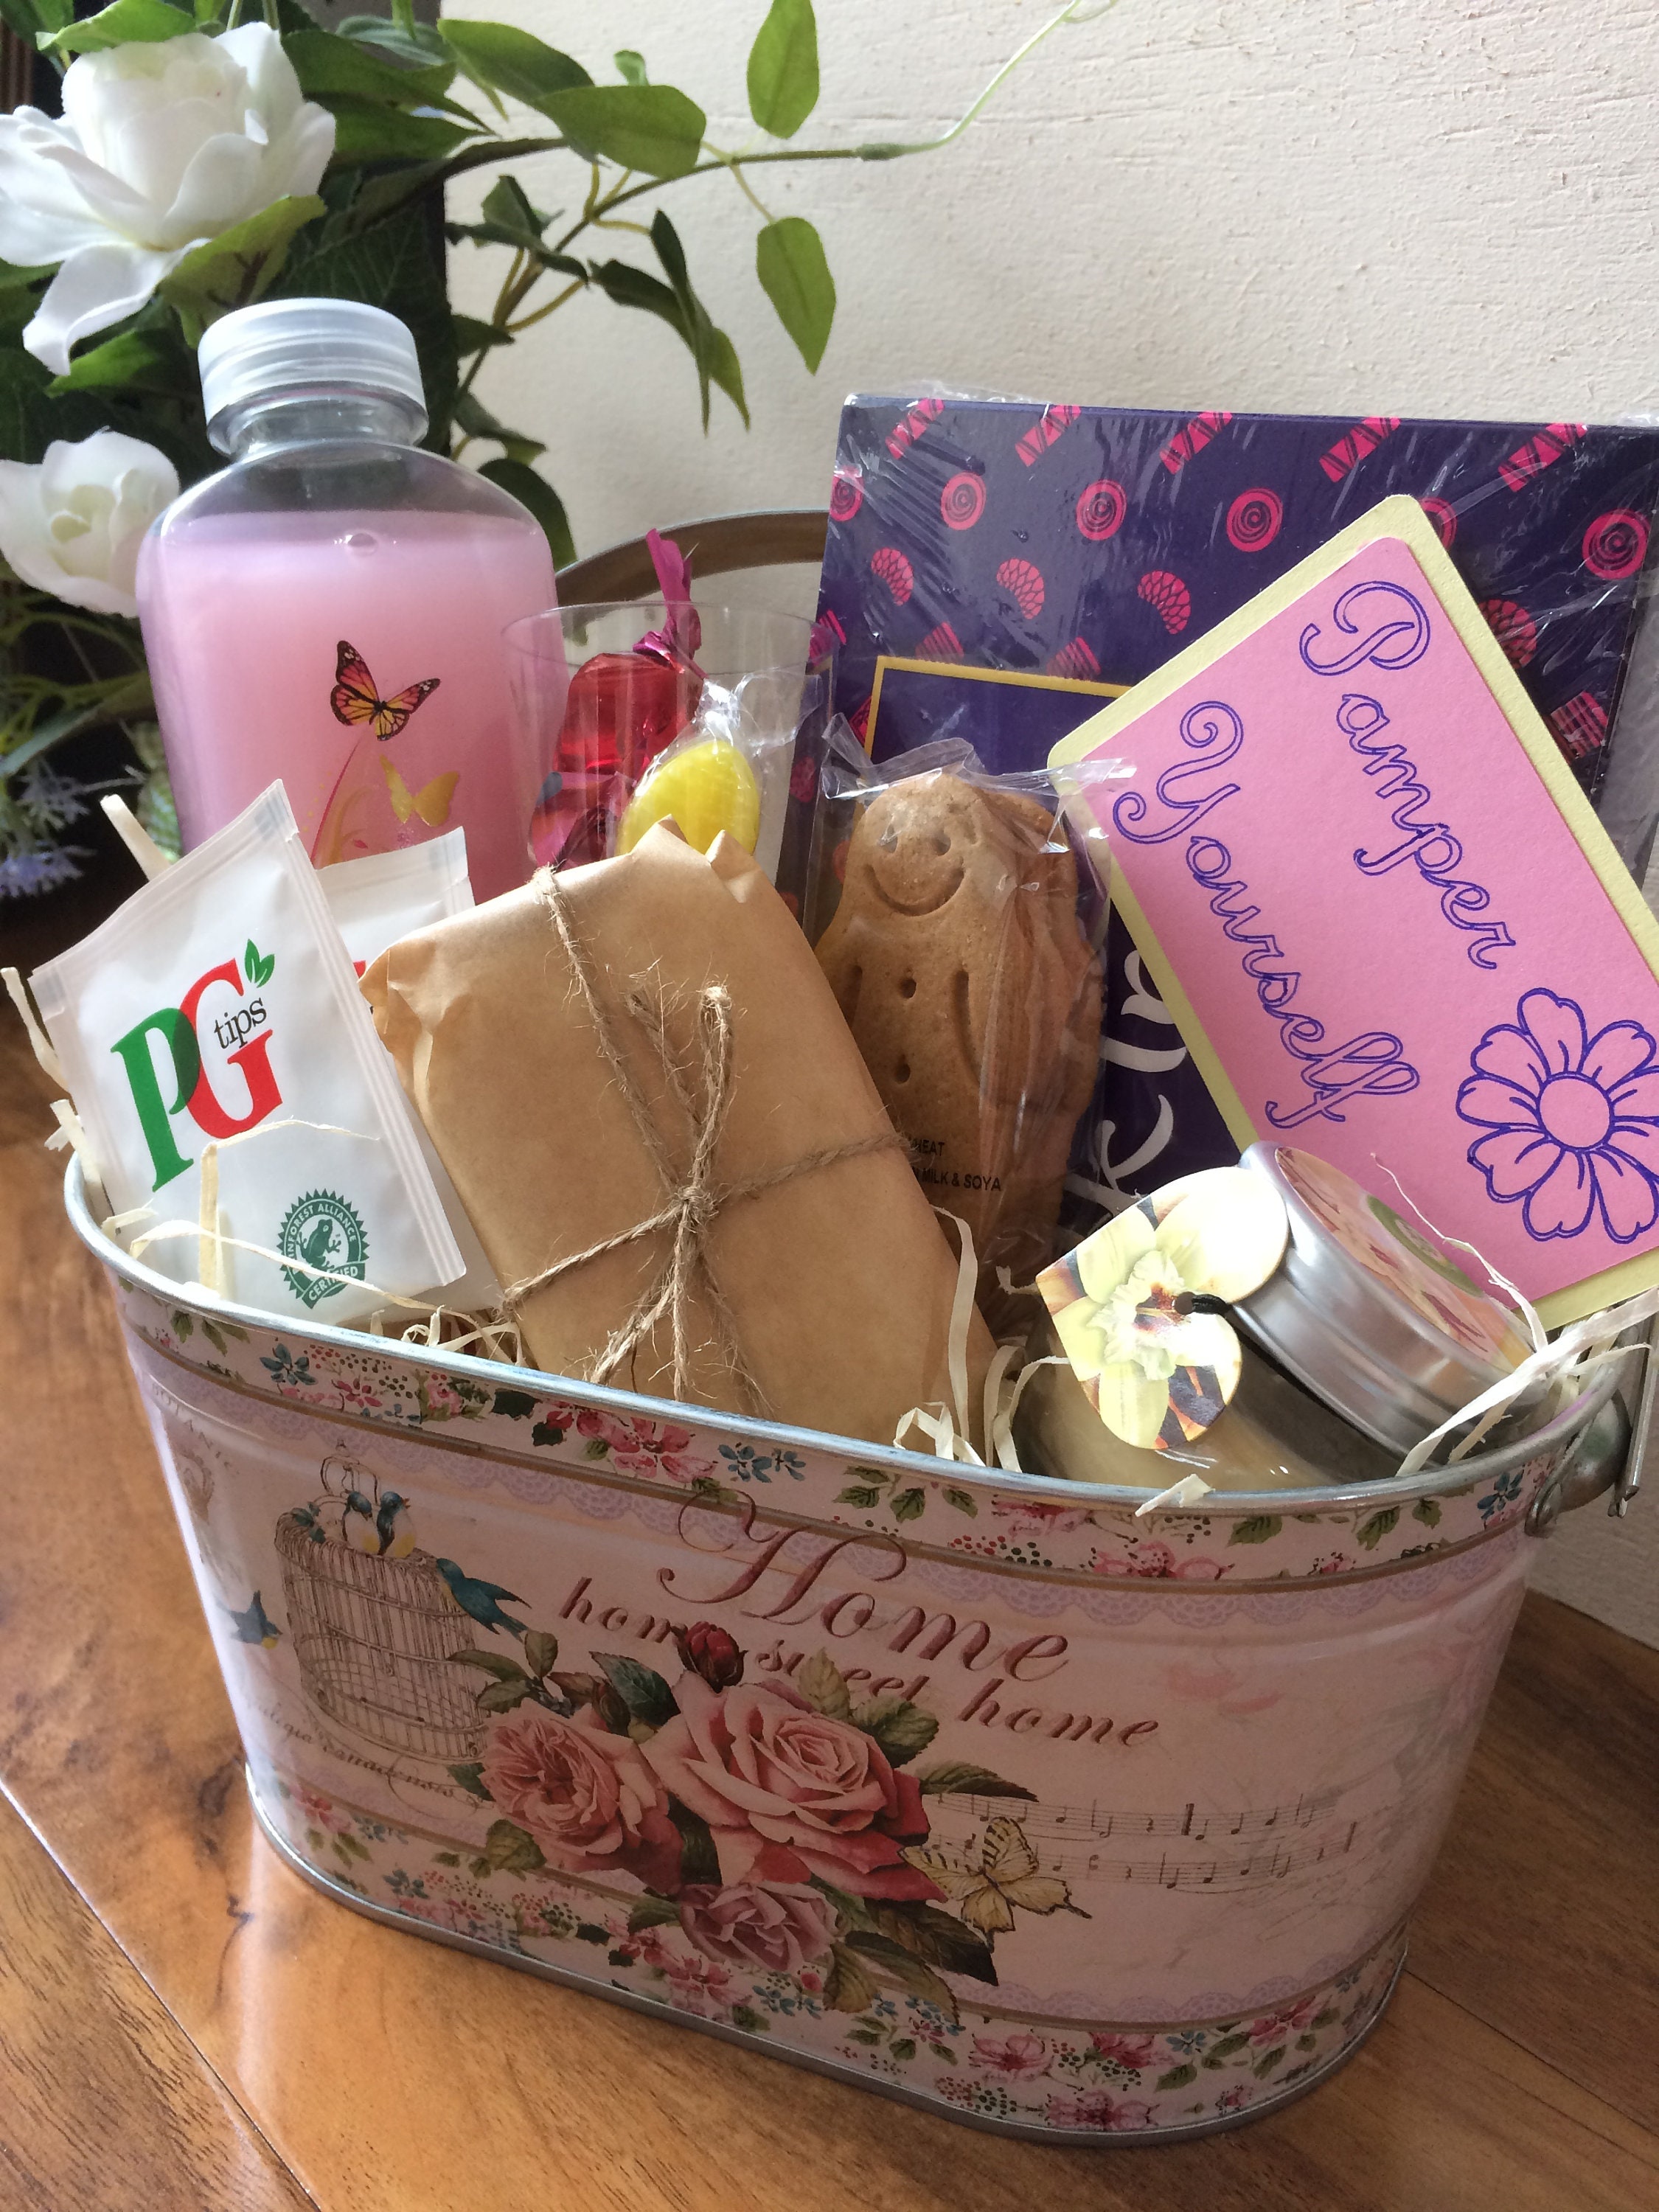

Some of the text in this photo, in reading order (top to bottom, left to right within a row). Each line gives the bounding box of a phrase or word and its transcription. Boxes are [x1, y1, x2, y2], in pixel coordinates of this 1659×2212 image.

[1299, 580, 1517, 970] Pamper
[1113, 700, 1420, 1130] Yourself
[111, 958, 283, 1193] PG
[213, 997, 268, 1050] tips
[910, 1138, 945, 1157] HEAT
[922, 1168, 949, 1185] MILK
[952, 1172, 960, 1187] &
[963, 1174, 1002, 1192] SOYA
[287, 1203, 357, 1272] INFOREST ALLIANCE
[559, 1577, 686, 1644] hom
[957, 1678, 1160, 1748] home
[655, 1487, 1071, 1683] Home
